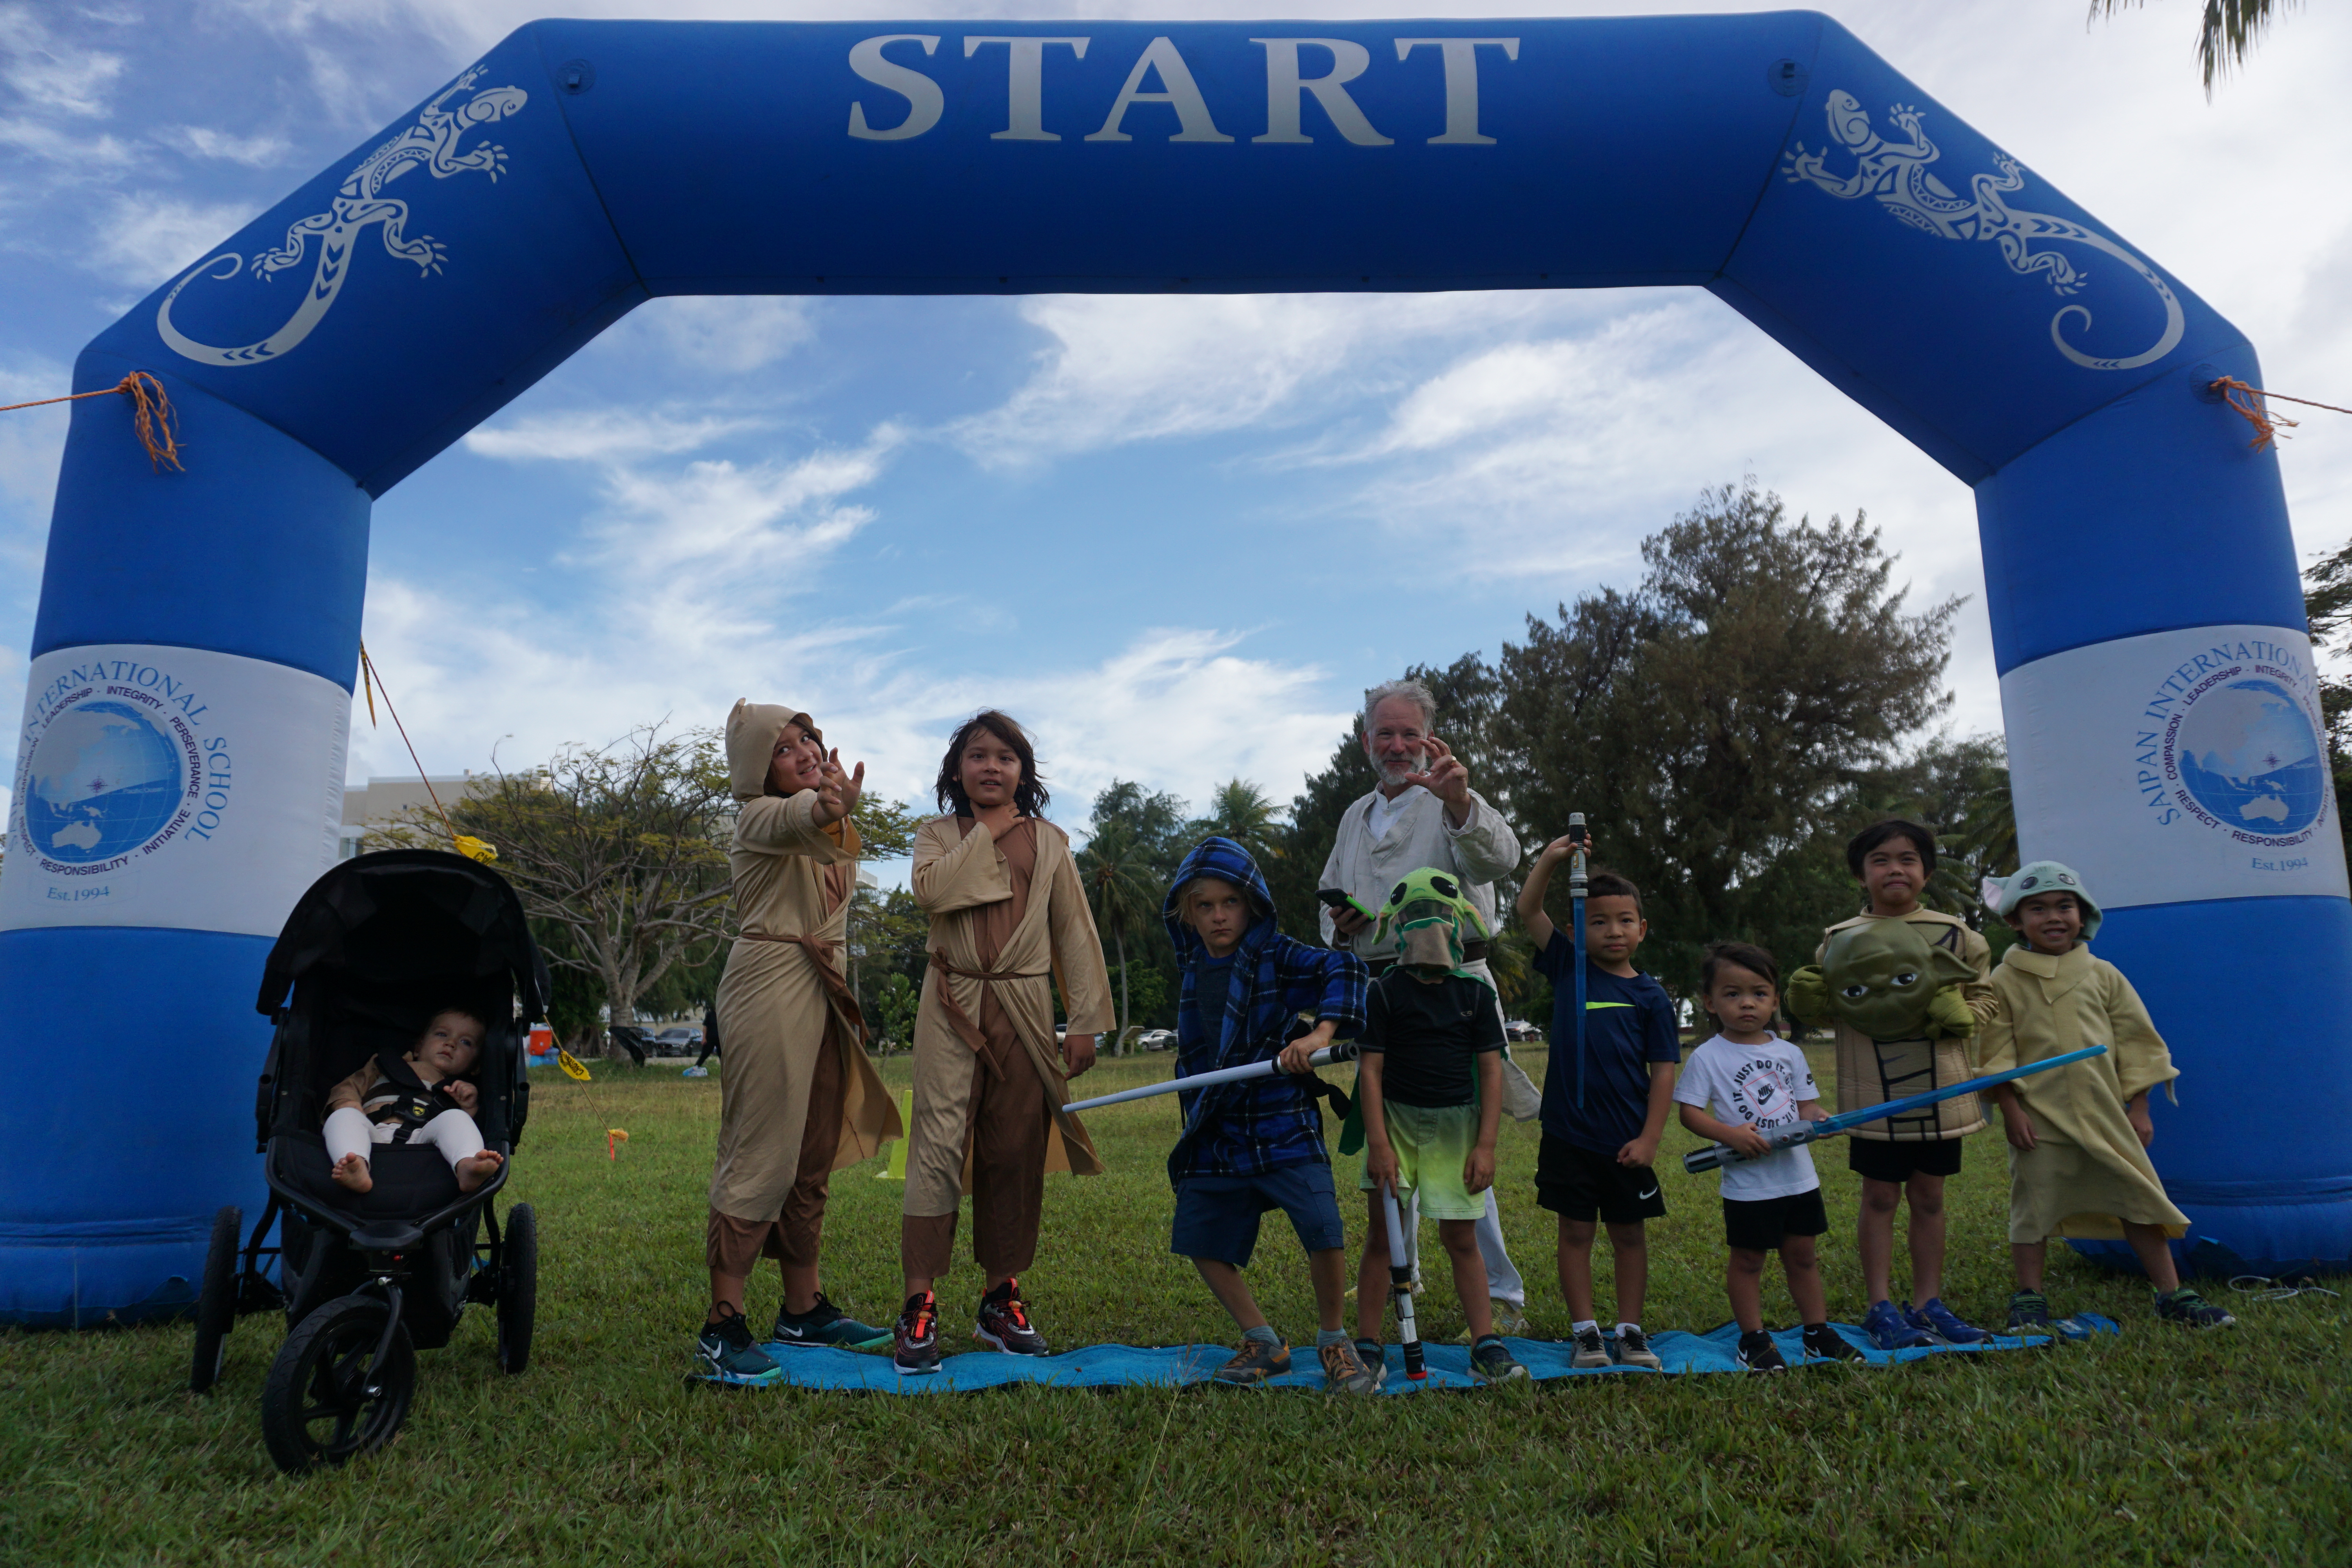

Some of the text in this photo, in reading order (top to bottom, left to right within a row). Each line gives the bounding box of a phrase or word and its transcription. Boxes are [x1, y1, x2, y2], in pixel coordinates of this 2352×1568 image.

[847, 34, 1521, 146] START
[2182, 666, 2241, 706] LEADERSHIP
[2255, 665, 2298, 688] INTEGRITY
[42, 688, 92, 729] LEADERSHIP
[107, 686, 163, 709] INTEGRITY
[25, 661, 208, 742] INTERNATIONAL
[184, 737, 231, 841] SCHOOL
[169, 716, 200, 799] PERSEVERANCE
[2164, 713, 2183, 780] COMPASSION
[2136, 731, 2181, 825] SAIPAN
[2175, 789, 2221, 829] RESPECT
[142, 809, 191, 855] INITIATIVE
[2232, 828, 2313, 847] RESPONSIBILITY
[39, 856, 128, 875] RESPONSIBILITY
[1734, 1063, 1754, 1085] JUST
[1756, 1060, 1772, 1069] DO
[1733, 1089, 1780, 1129] JUST DO IT.
